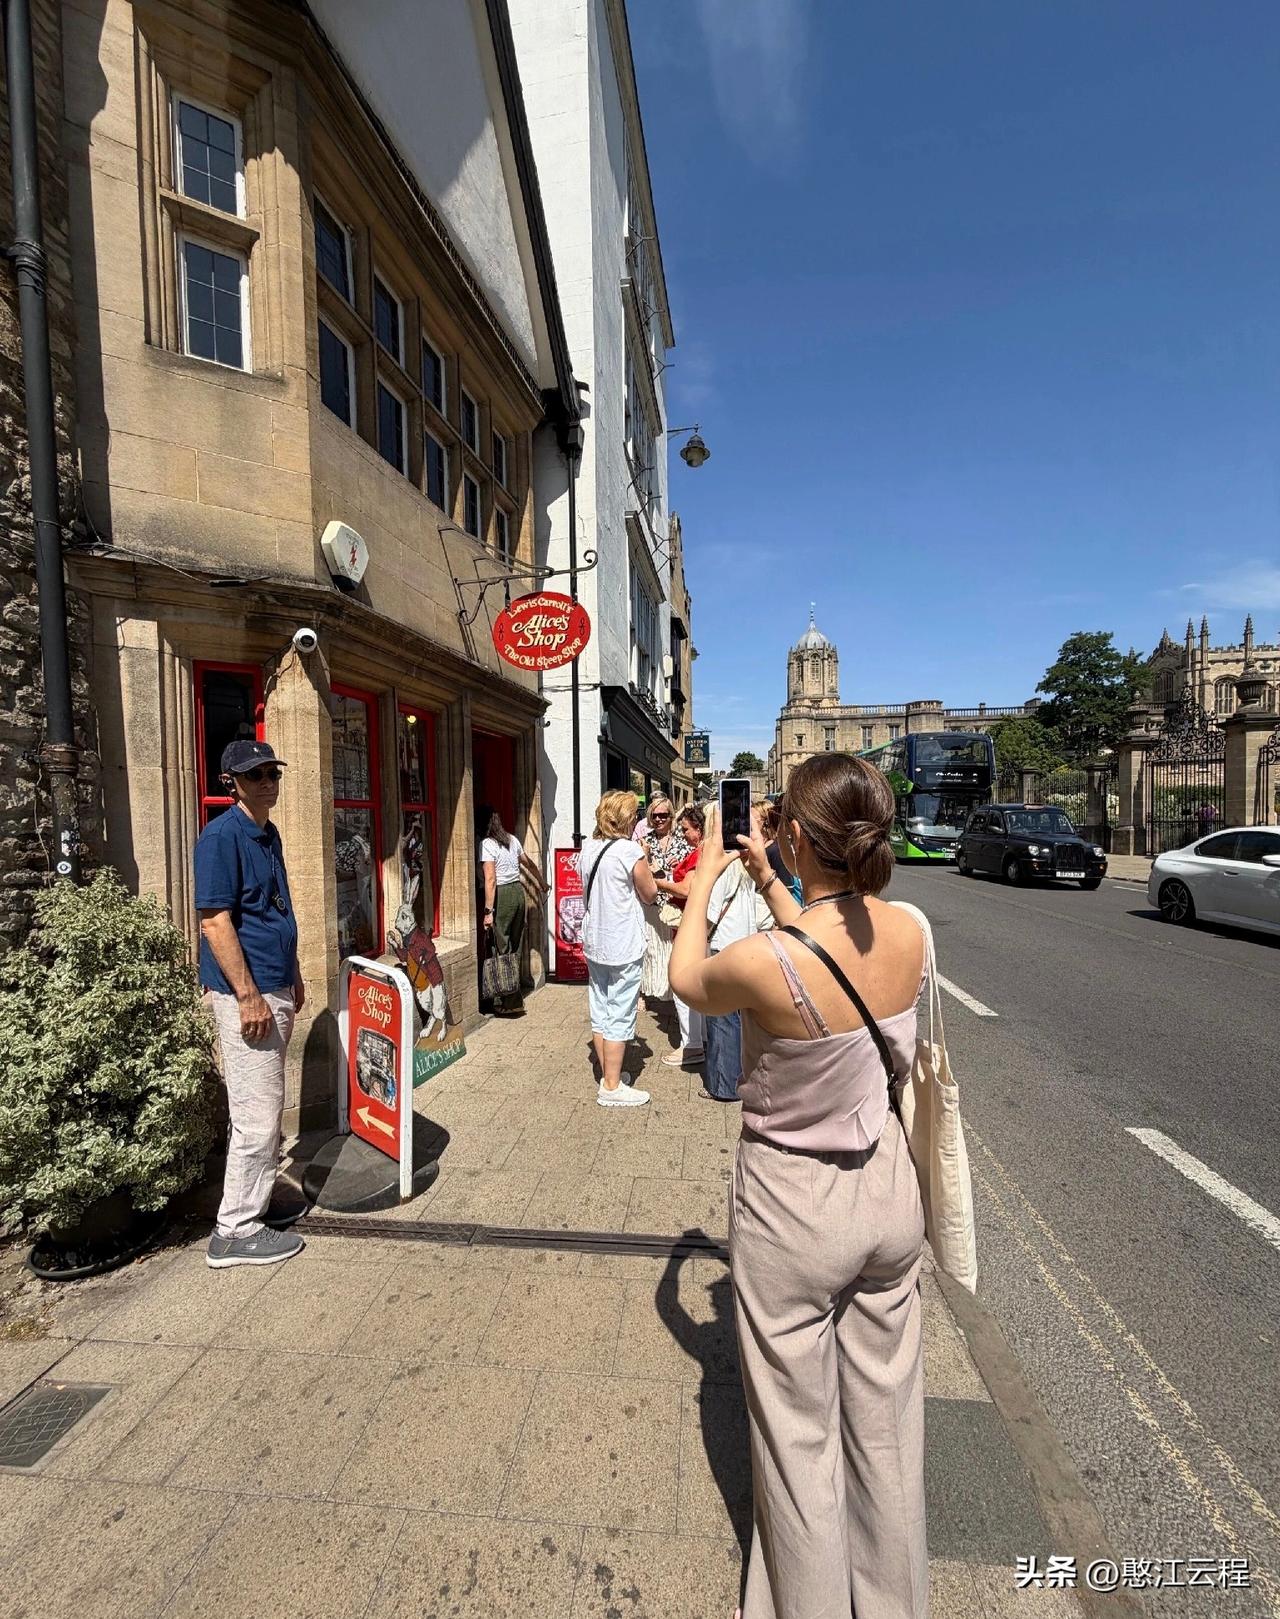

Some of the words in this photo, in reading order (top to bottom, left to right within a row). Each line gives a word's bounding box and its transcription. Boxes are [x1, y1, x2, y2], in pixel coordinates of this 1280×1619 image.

[507, 598, 537, 618] Lewis
[537, 597, 574, 614] Carroll's
[511, 614, 570, 633] Alice's
[517, 627, 567, 651] Shop
[504, 644, 519, 662] The
[519, 655, 535, 667] Old
[537, 654, 562, 669] Sheep
[562, 637, 582, 659] Shop
[358, 985, 393, 1011] Alice's
[361, 996, 392, 1029] Shop
[415, 1049, 443, 1078] ALICE'S
[443, 1038, 461, 1061] SHOP
